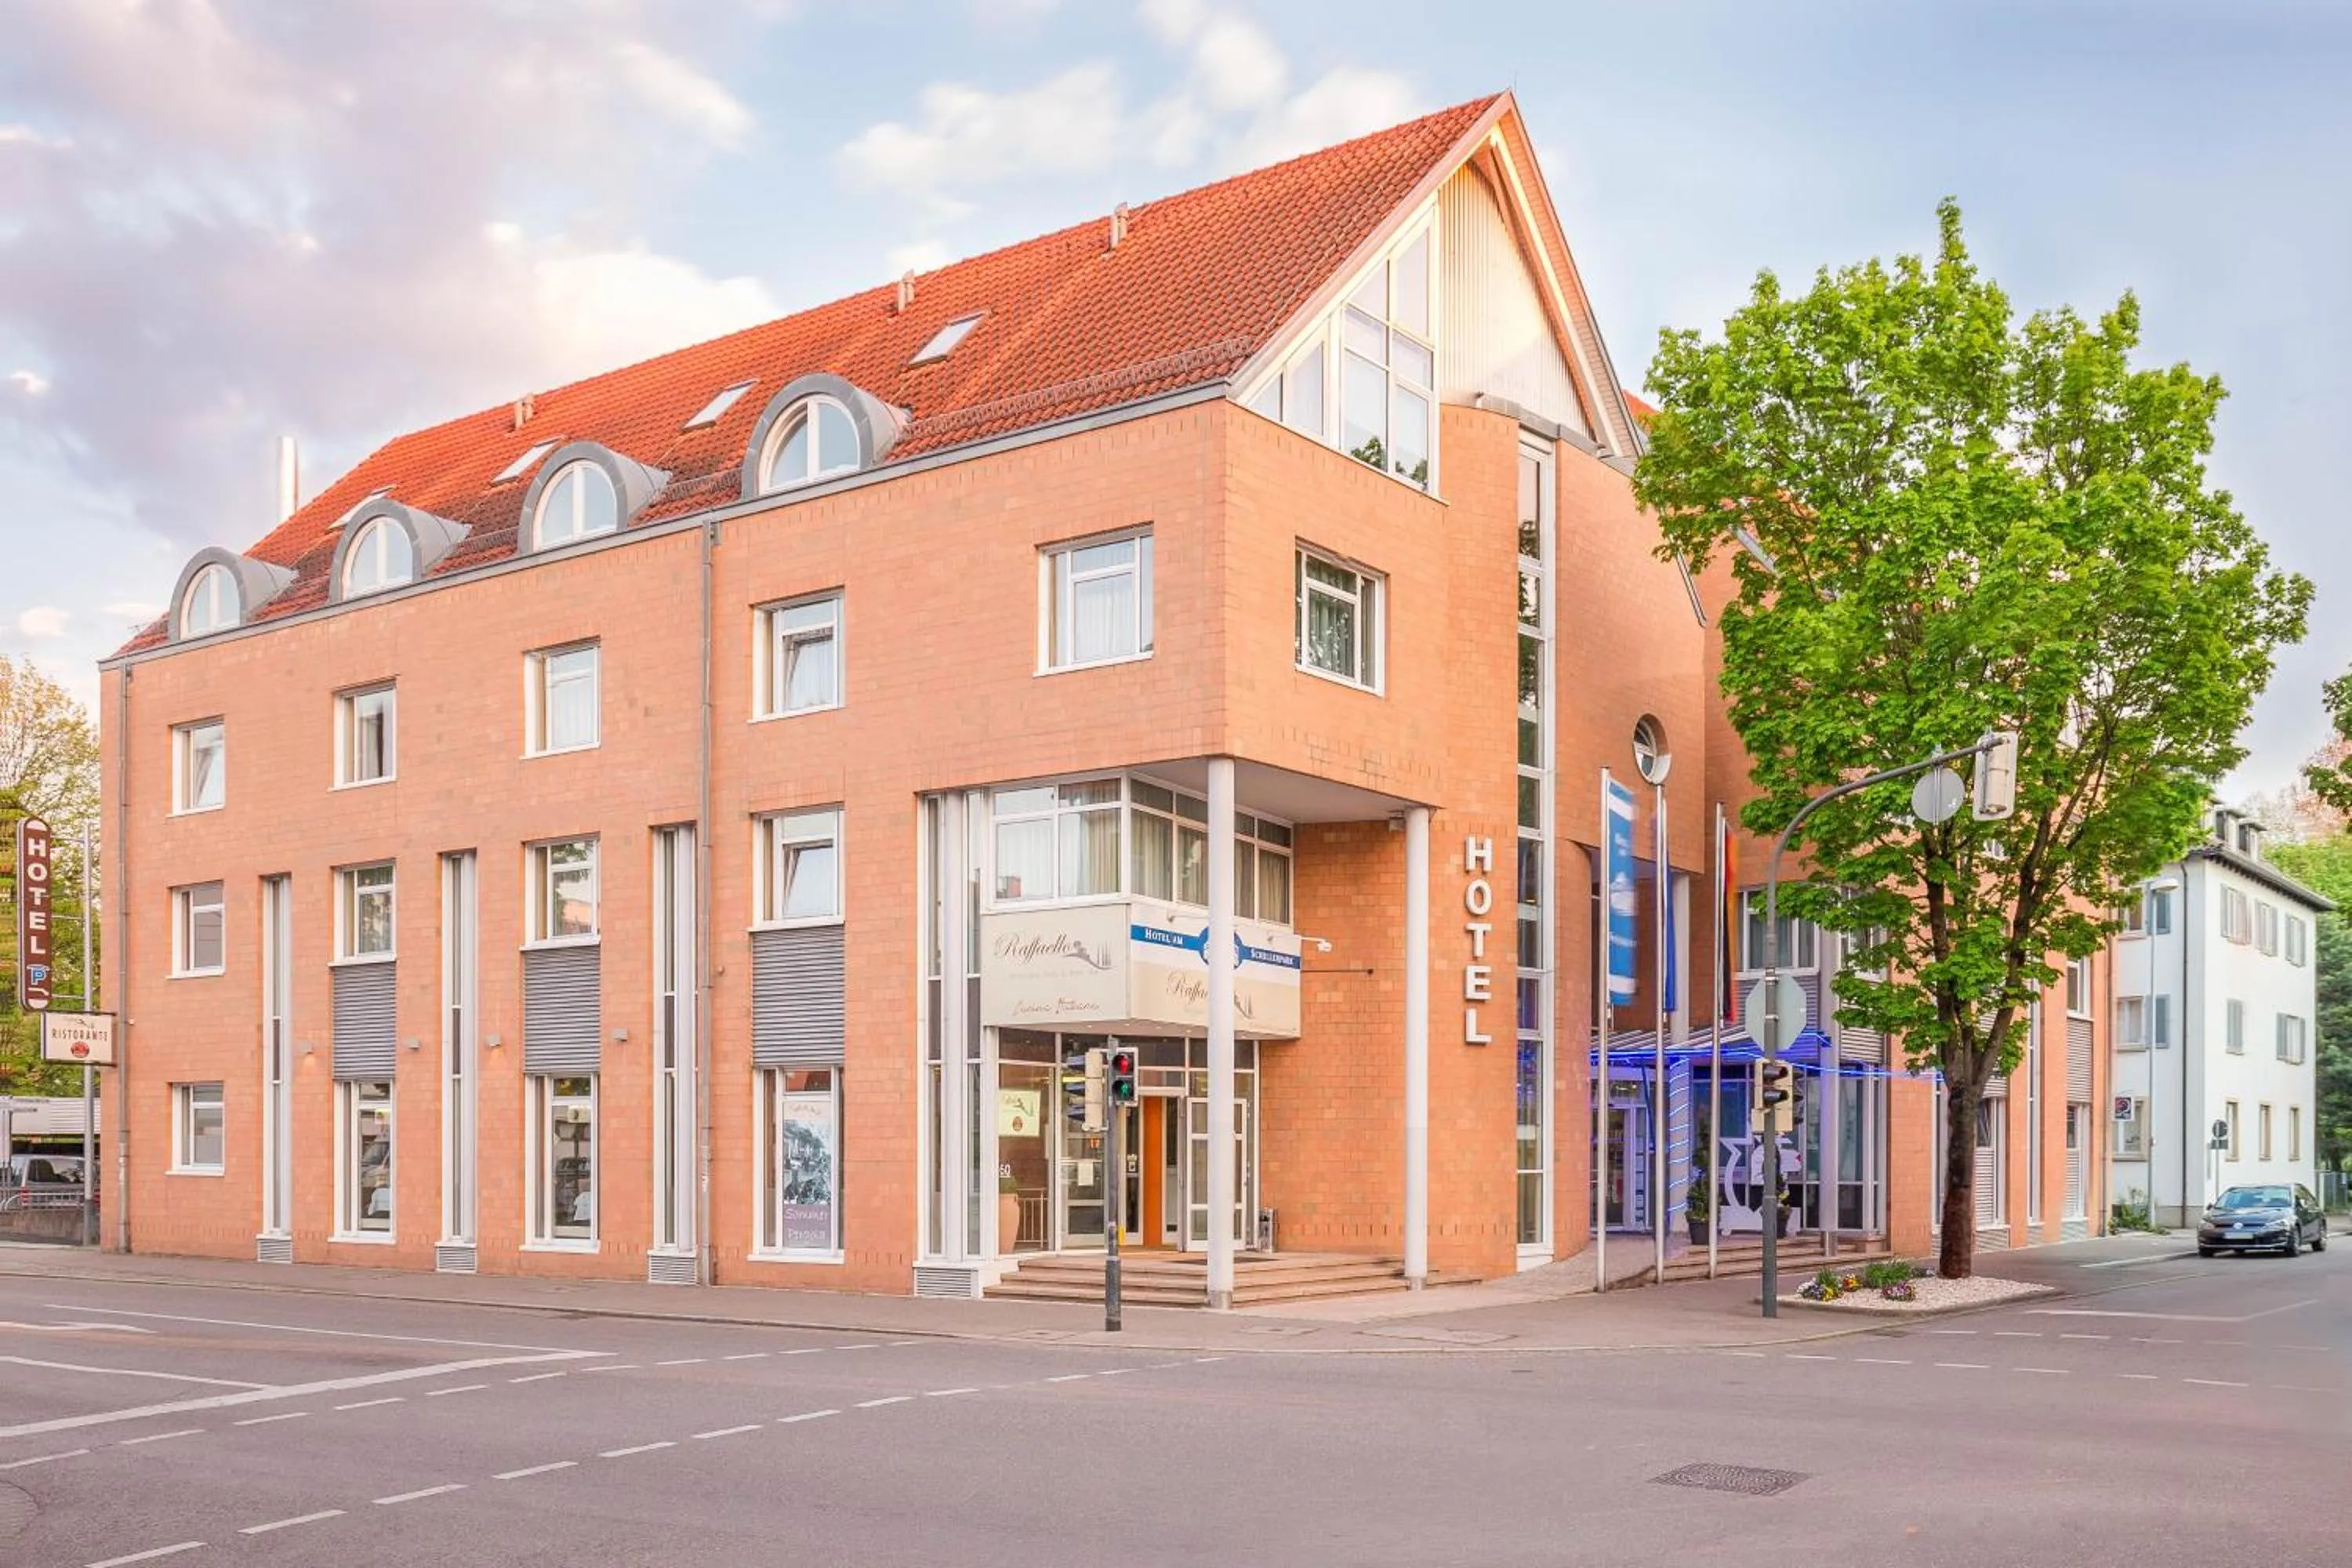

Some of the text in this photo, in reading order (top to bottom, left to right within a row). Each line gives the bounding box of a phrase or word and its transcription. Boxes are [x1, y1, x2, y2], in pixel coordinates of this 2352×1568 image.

[27, 838, 48, 954] HOTEL
[993, 928, 1071, 965] Raffaello
[1465, 836, 1493, 1044] HOTEL
[30, 968, 47, 985] P
[52, 1028, 107, 1042] RISTORANTE
